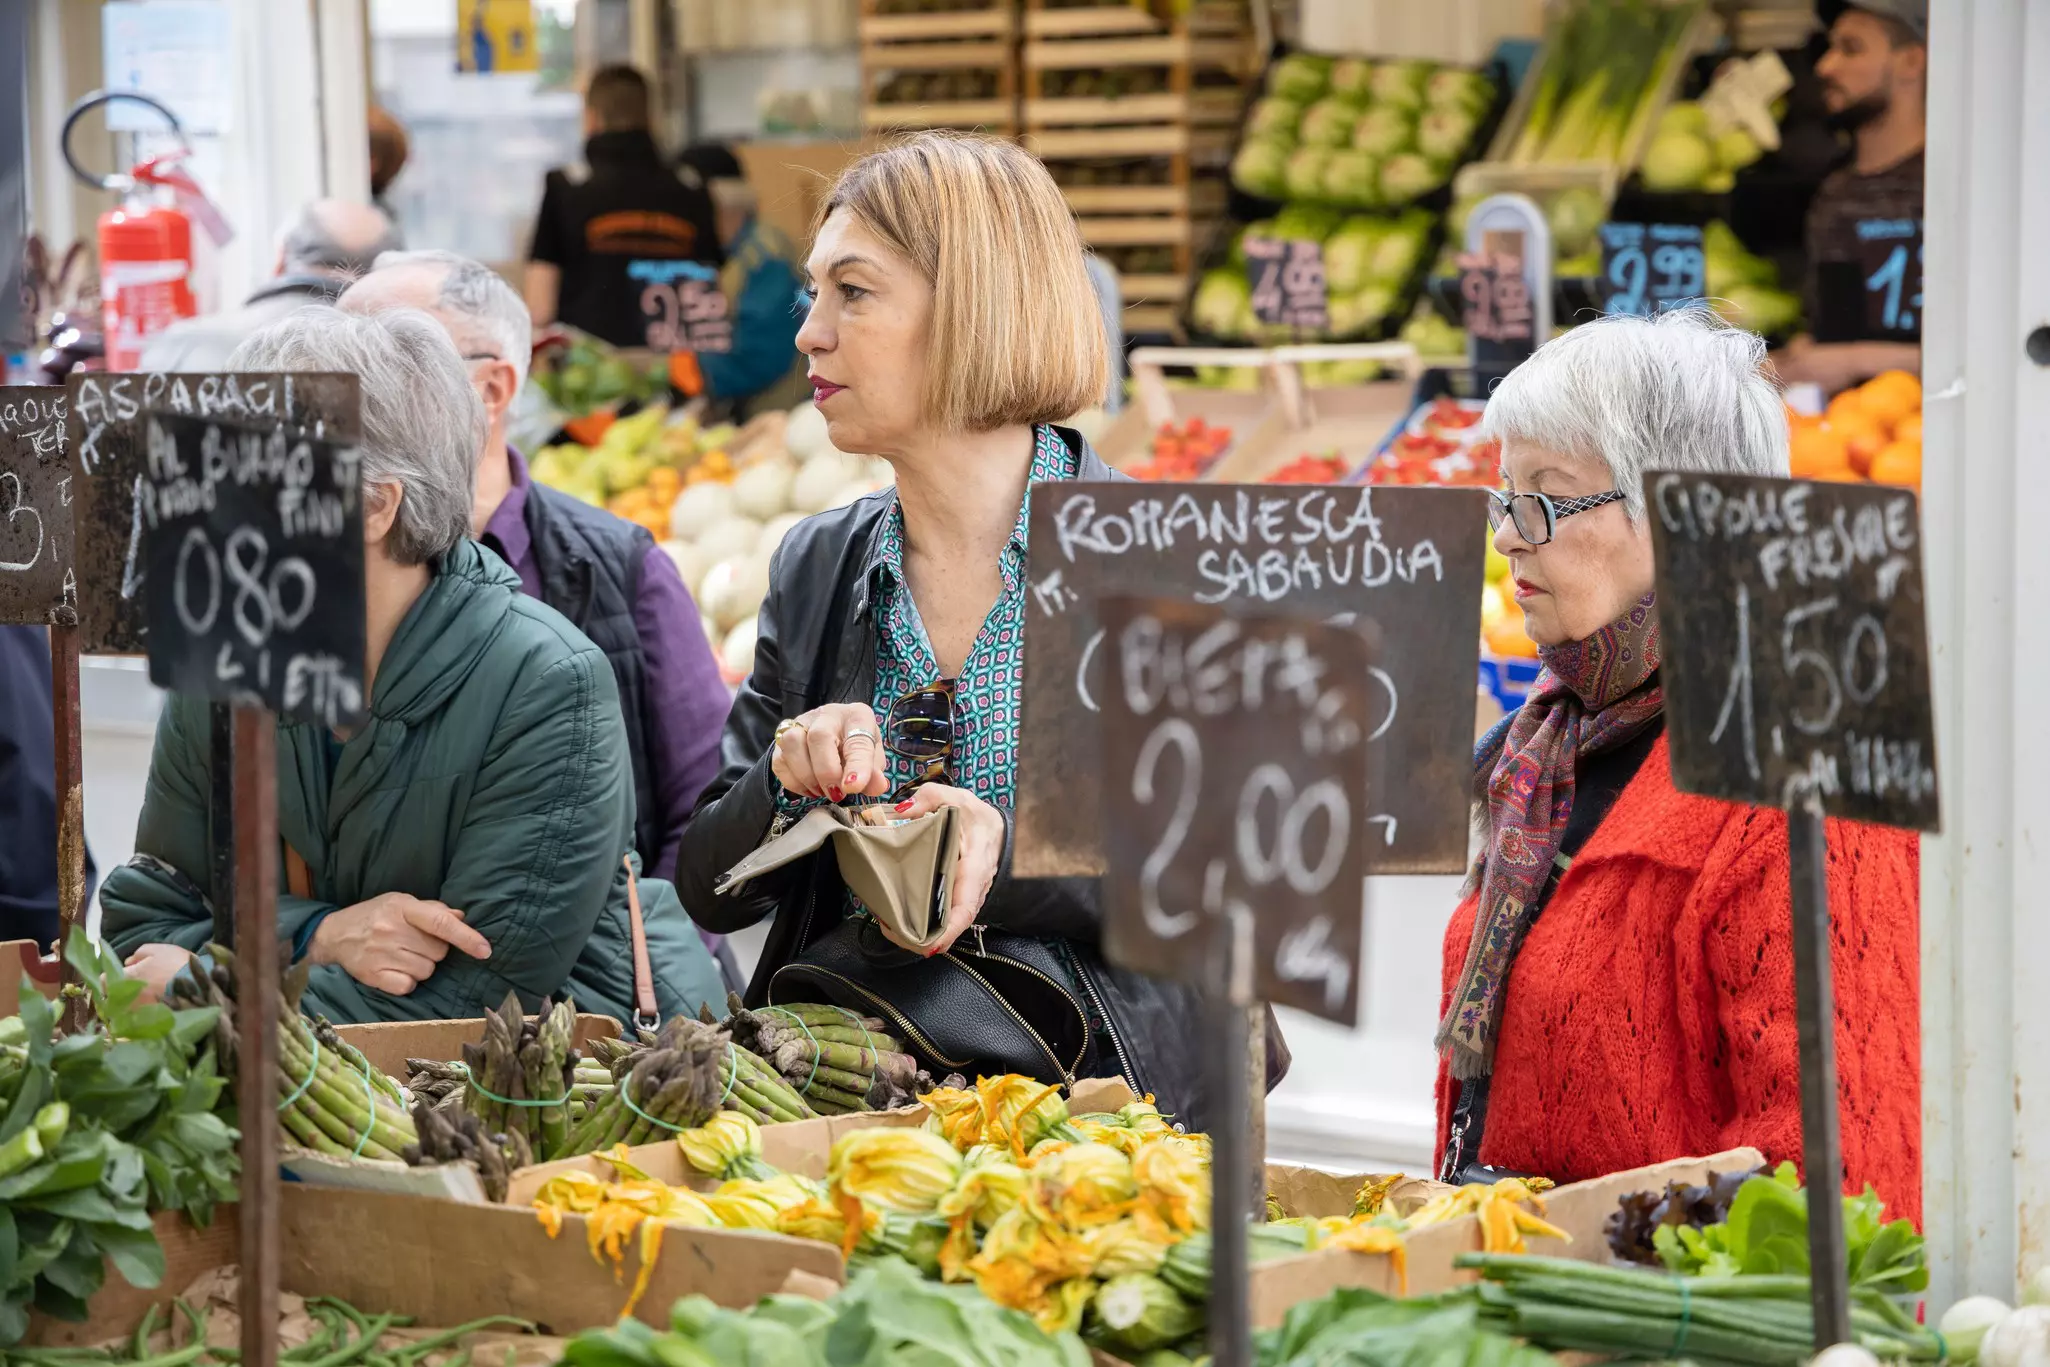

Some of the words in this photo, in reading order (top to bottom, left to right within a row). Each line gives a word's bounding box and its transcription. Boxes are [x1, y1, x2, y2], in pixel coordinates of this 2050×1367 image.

[75, 375, 294, 425] ASPARAGI
[1055, 487, 1383, 562] ROMANESCA
[1194, 538, 1444, 602] SABAUDIA
